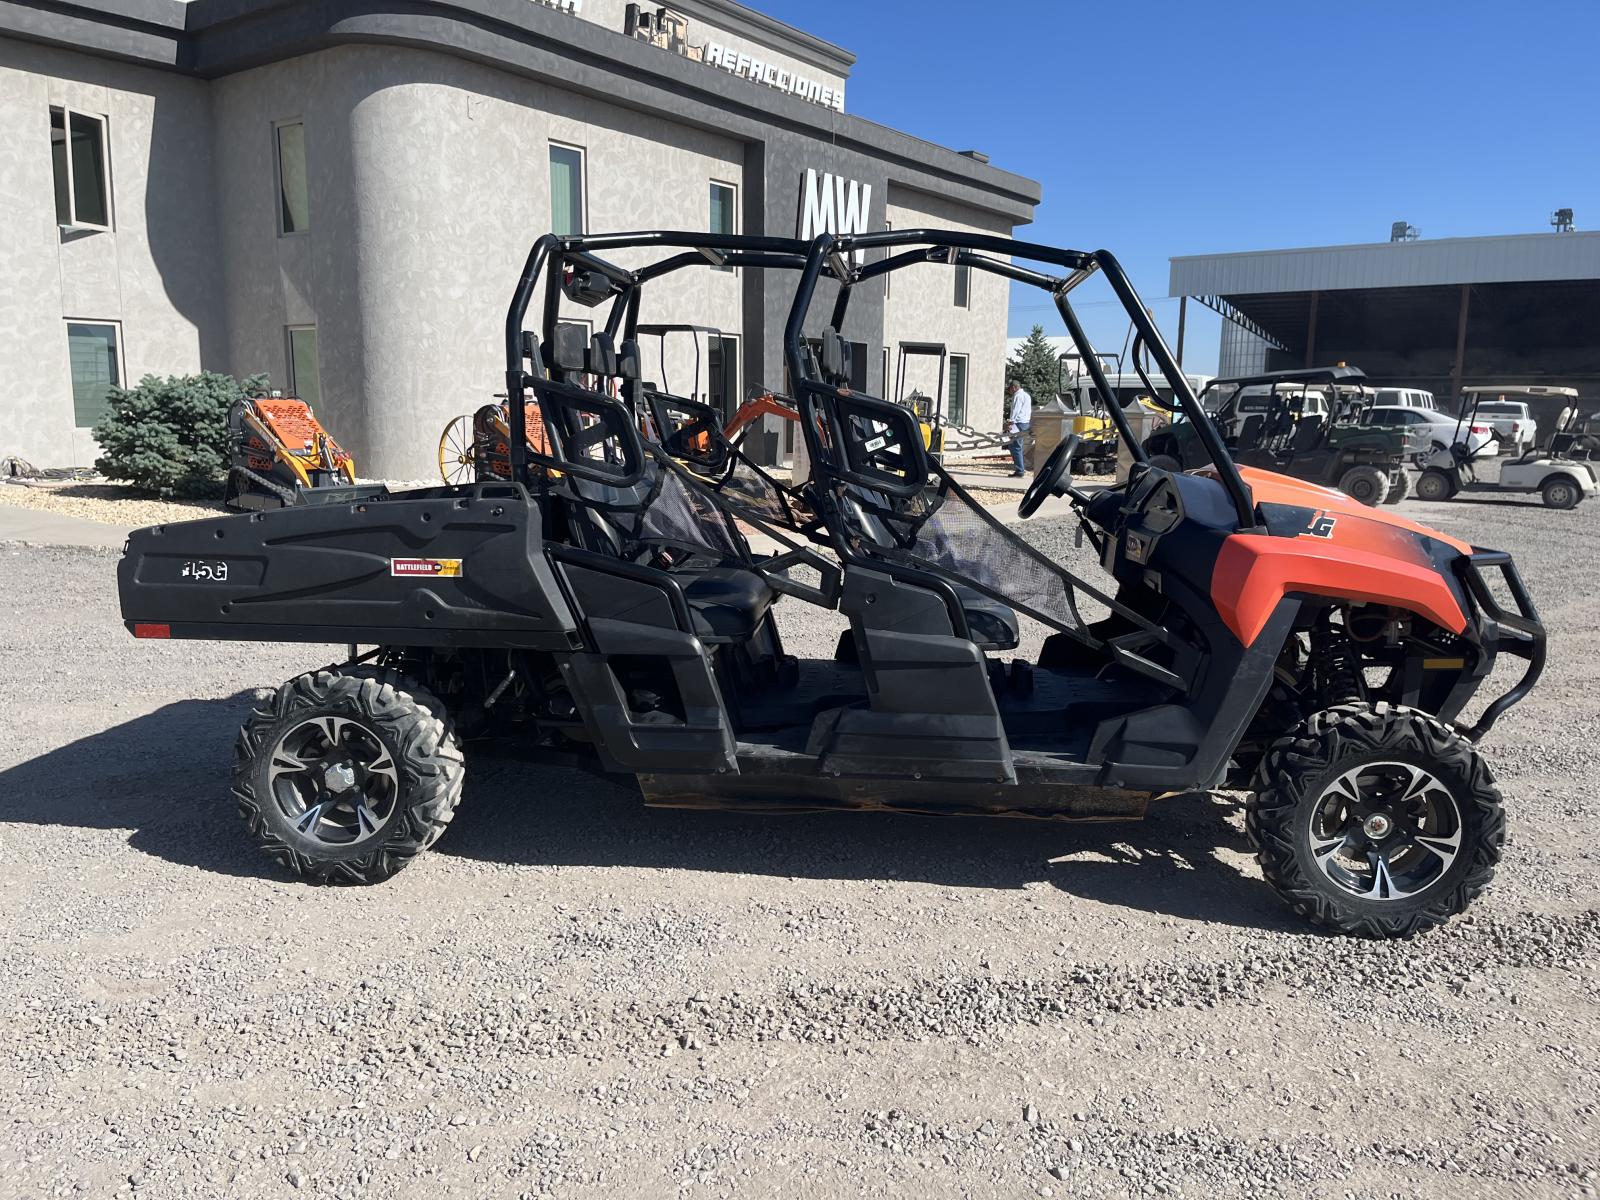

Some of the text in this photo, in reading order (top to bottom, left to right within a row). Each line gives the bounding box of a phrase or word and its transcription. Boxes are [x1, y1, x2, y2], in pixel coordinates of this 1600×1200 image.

[706, 41, 844, 109] REFACCIONES
[802, 168, 871, 264] MW
[396, 563, 433, 571] BATTLEFIELD
